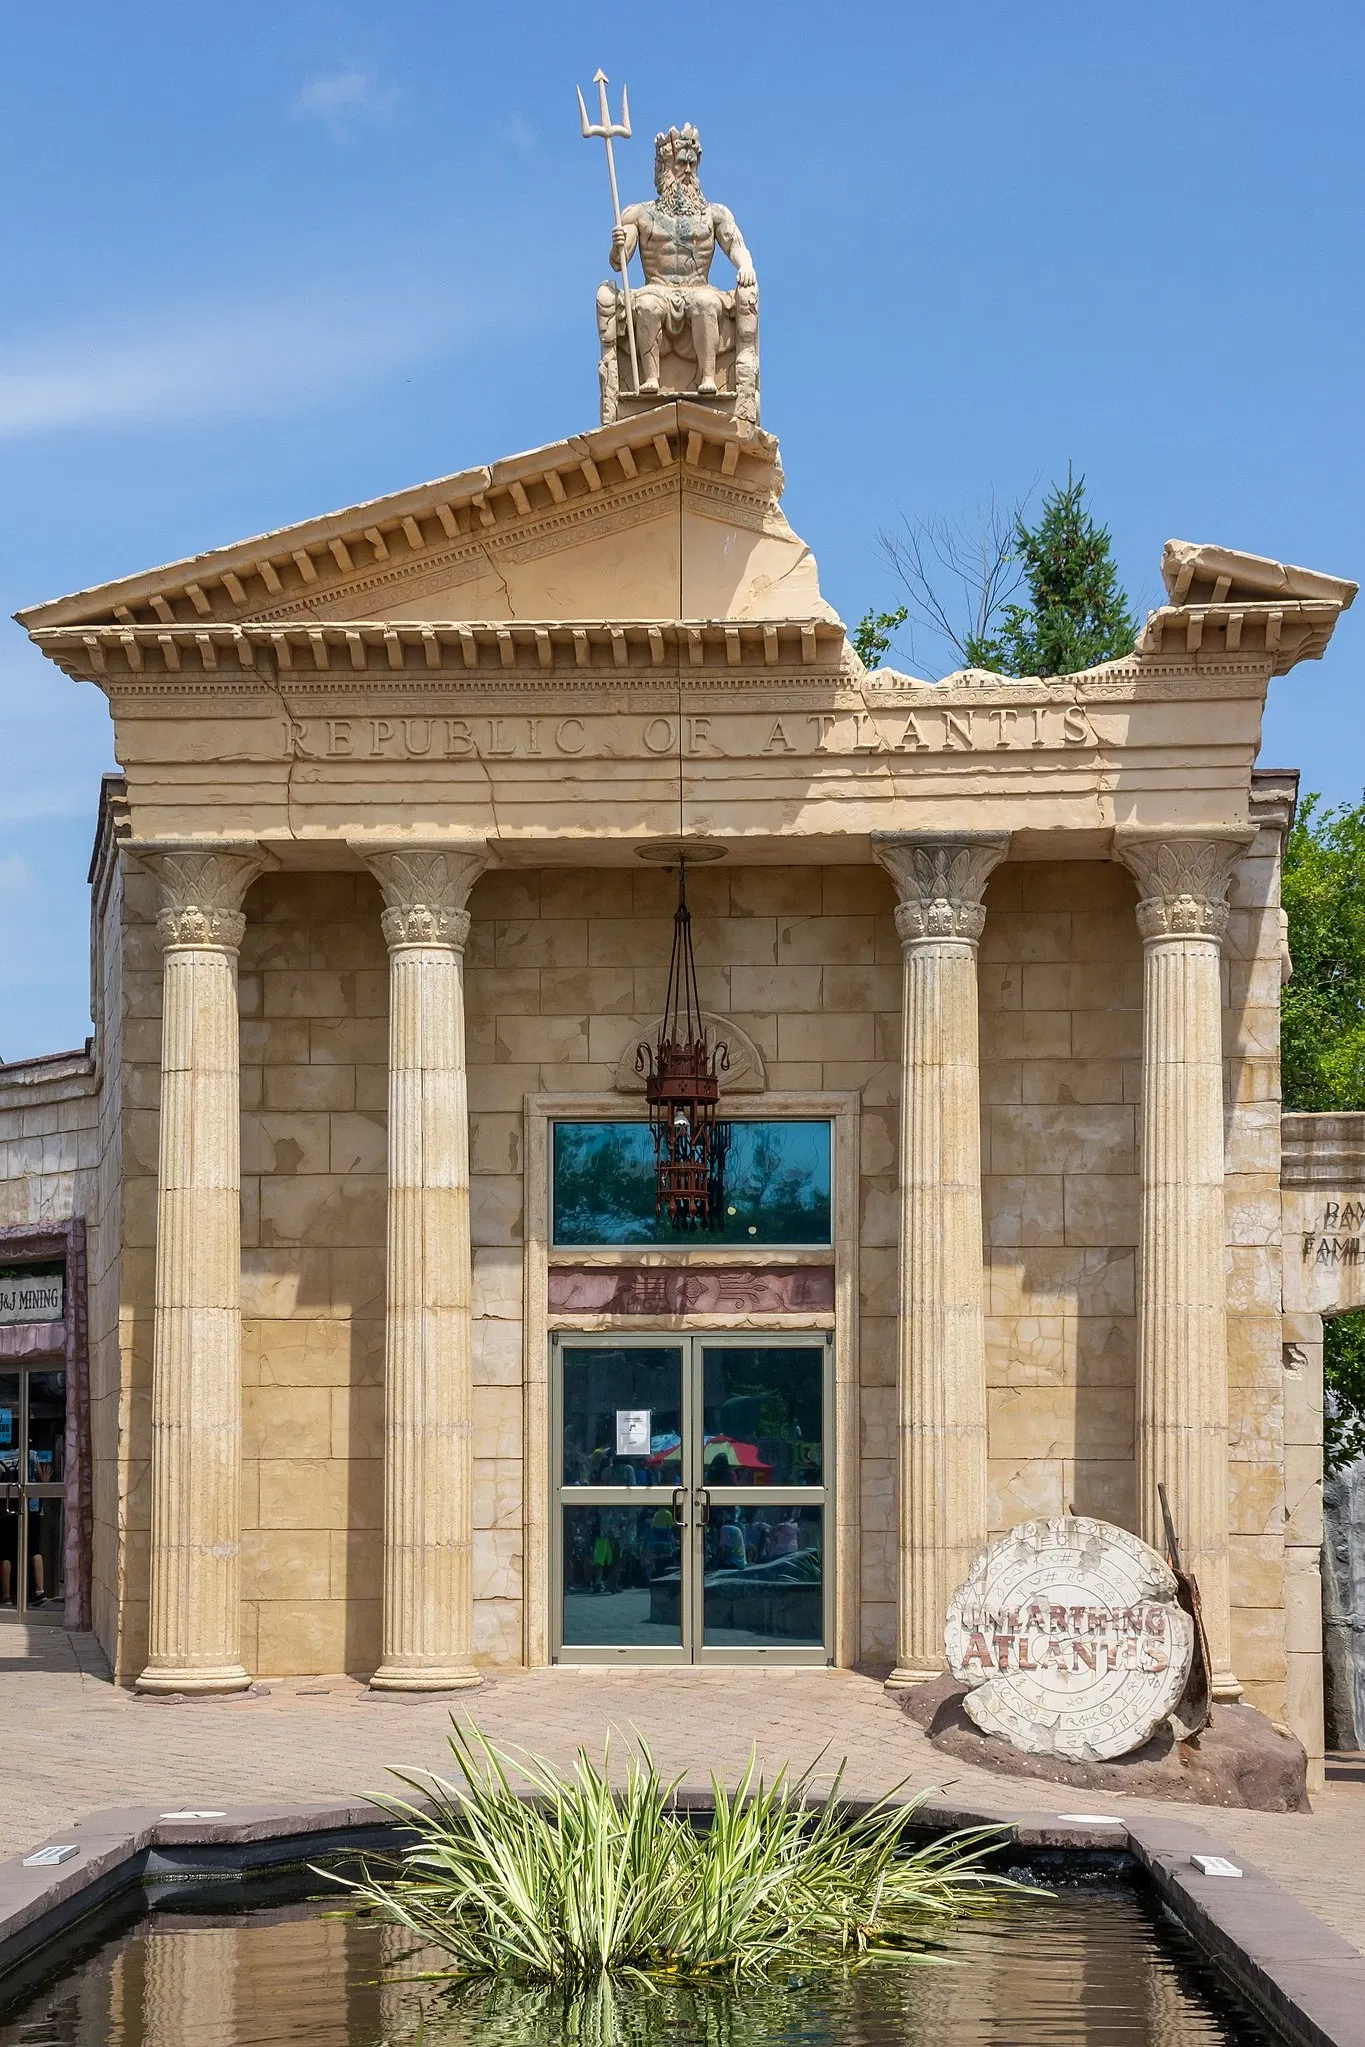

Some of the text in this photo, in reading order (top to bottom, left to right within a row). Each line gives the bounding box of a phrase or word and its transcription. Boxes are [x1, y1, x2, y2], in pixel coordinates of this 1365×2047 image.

[282, 705, 1090, 757] REPUBLIC OF ATLANTIS
[18, 1288, 59, 1310] MINING
[960, 1603, 1166, 1634] UNEARTHING
[960, 1632, 1170, 1673] ATLANTIS
